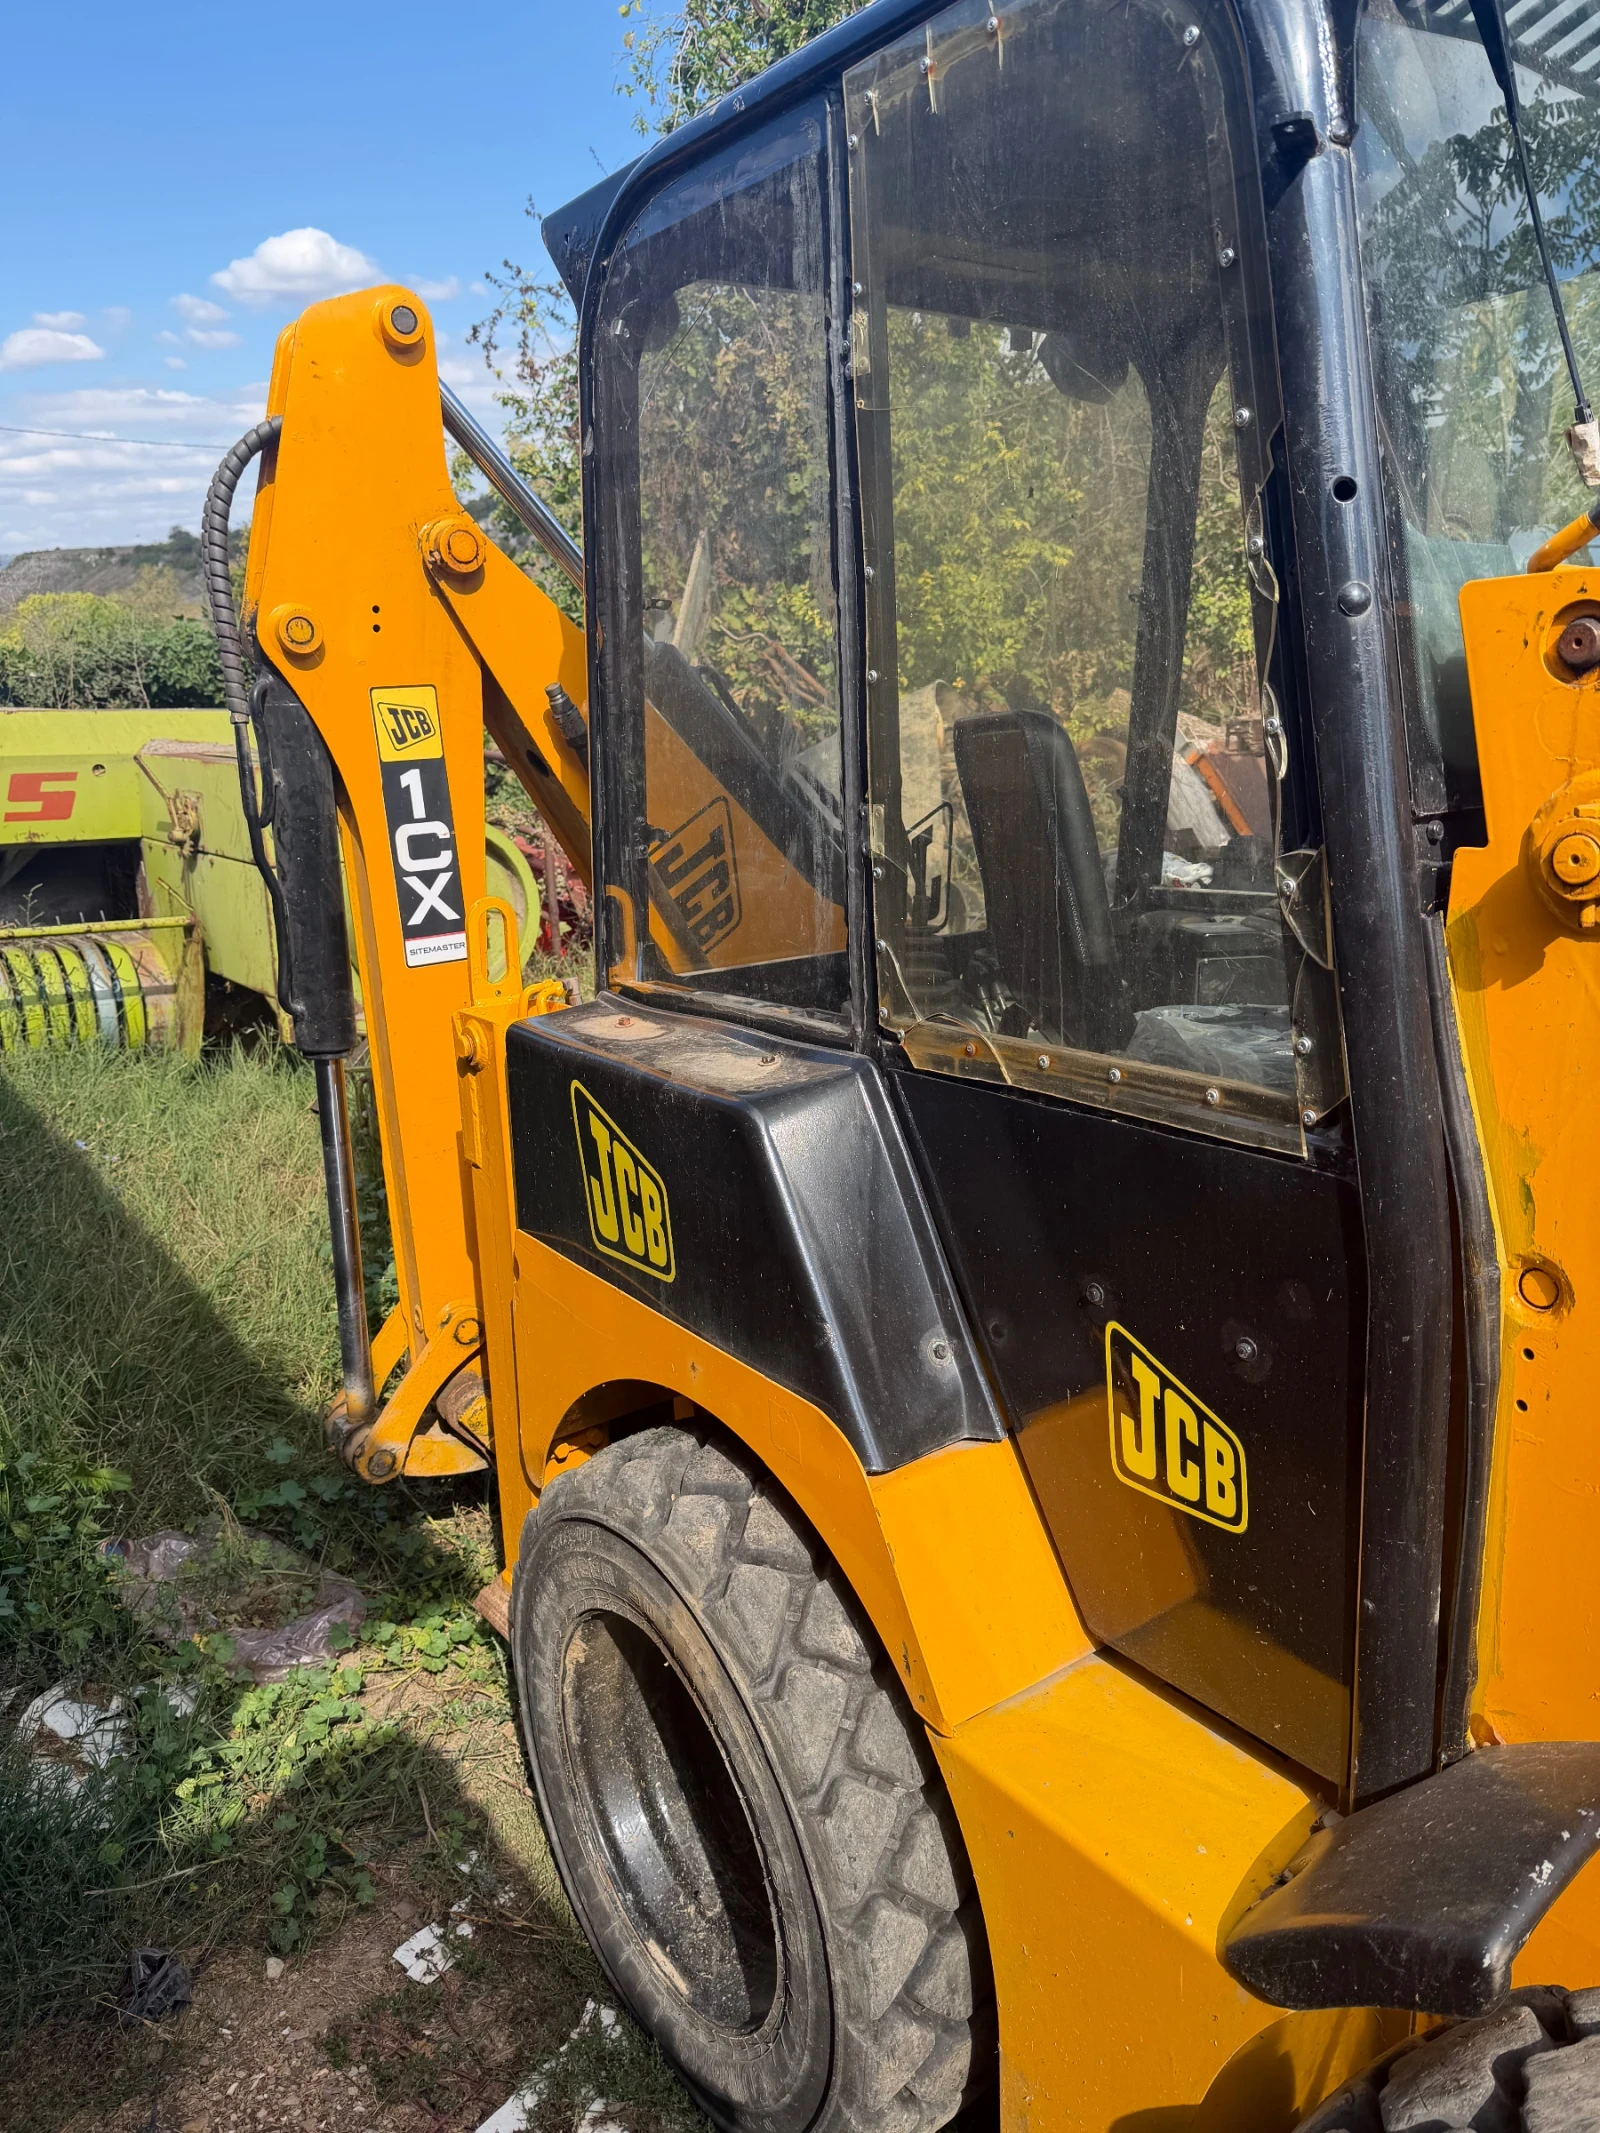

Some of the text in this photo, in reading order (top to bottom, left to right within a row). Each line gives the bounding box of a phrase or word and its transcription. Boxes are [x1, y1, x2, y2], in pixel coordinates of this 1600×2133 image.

[387, 708, 432, 745] JCB
[395, 768, 461, 926] 1CX
[652, 824, 735, 946] JCB
[409, 941, 466, 956] SITEMASTER
[589, 1109, 668, 1268] JCB
[1120, 1352, 1237, 1518] JCB
